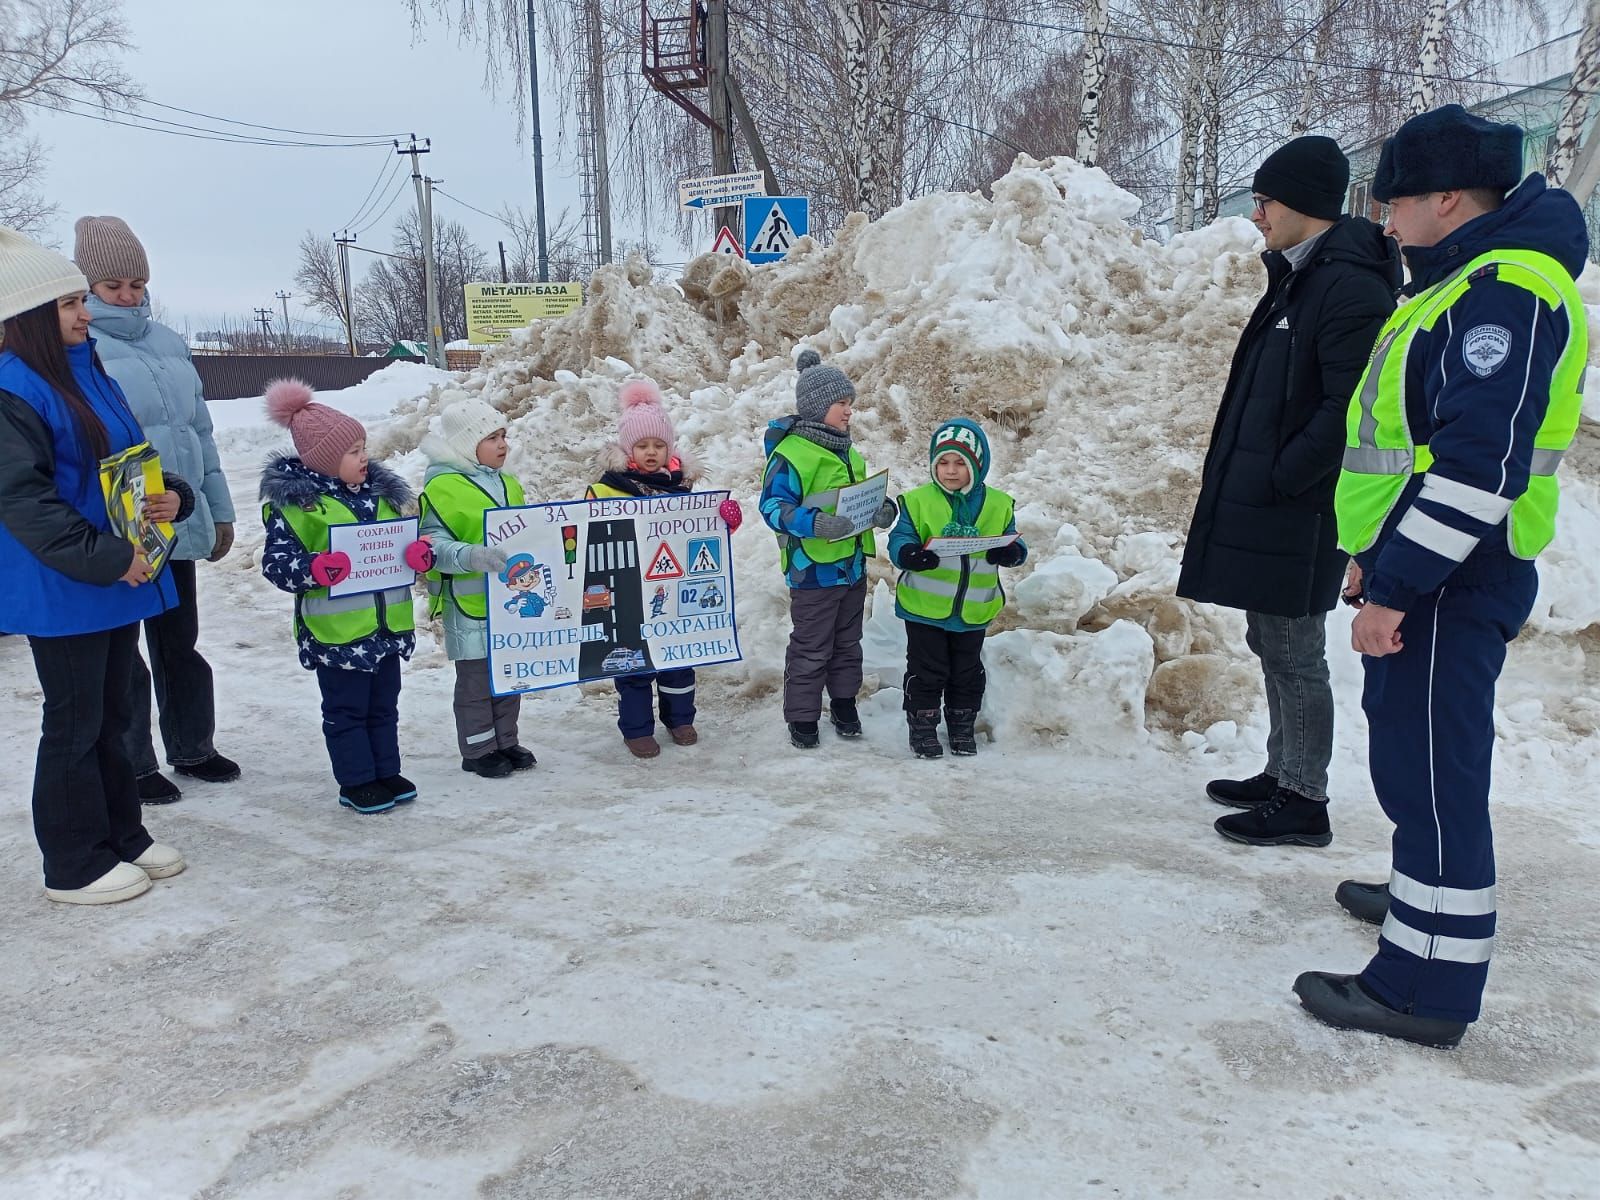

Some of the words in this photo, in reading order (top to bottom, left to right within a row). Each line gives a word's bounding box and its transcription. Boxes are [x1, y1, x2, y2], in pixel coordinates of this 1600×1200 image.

[681, 182, 702, 190] СКЛАД
[688, 189, 712, 198] ЦЕМЕНТ
[731, 183, 756, 192] КРОВЛЯ
[481, 286, 568, 297] МЕТАЛЛ-БАЗА
[1469, 335, 1504, 348] РОССИЯ
[487, 514, 528, 546] МЫ
[544, 506, 569, 524] ЗА
[588, 494, 718, 518] БЕЗОПАСНЫЕ
[357, 525, 404, 538] СОХРАНИ
[646, 516, 718, 540] ДОРОГИ
[359, 540, 394, 552] ЖИЗНЬ
[363, 553, 395, 565] СБАВЬ
[347, 565, 403, 580] СКОРОСТЬ!
[681, 588, 697, 604] 02
[492, 625, 609, 651] ВОДИТЕЛЬ,
[641, 613, 733, 637] СОХРАНИ
[514, 657, 576, 679] ВСЕМ
[662, 640, 733, 662] ЖИЗНЬ!
